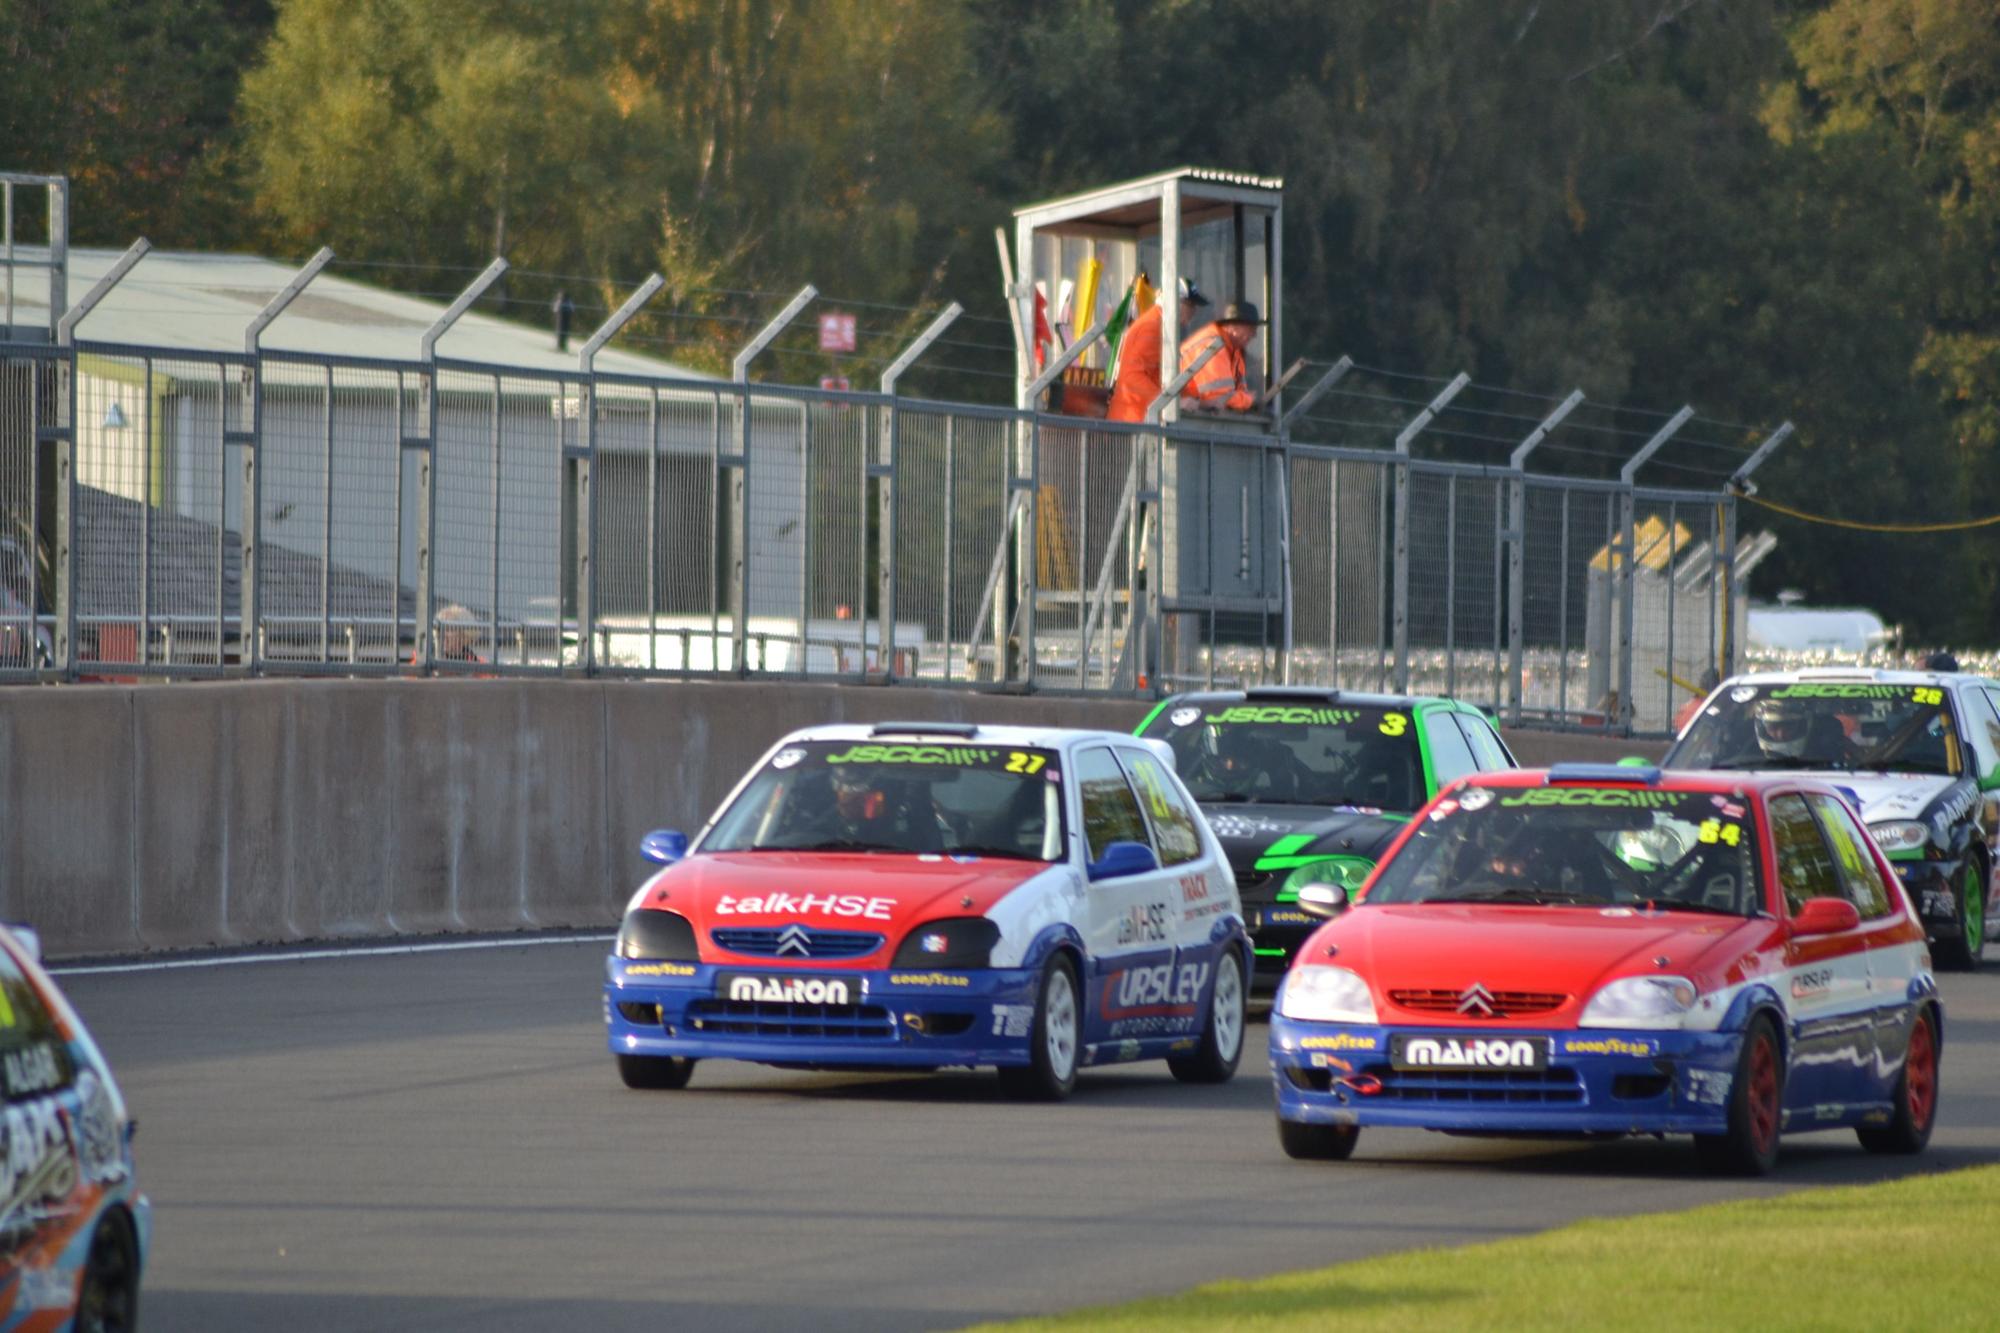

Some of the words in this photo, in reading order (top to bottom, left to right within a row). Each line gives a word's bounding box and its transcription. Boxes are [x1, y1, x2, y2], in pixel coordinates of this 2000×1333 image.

[1205, 707, 1312, 723] JSCC
[1379, 713, 1407, 736] 3
[826, 746, 944, 764] JSCC
[1004, 752, 1046, 774] 27
[1501, 788, 1632, 806] JSCC
[1698, 820, 1741, 847] 64
[715, 892, 898, 920] talkHSE
